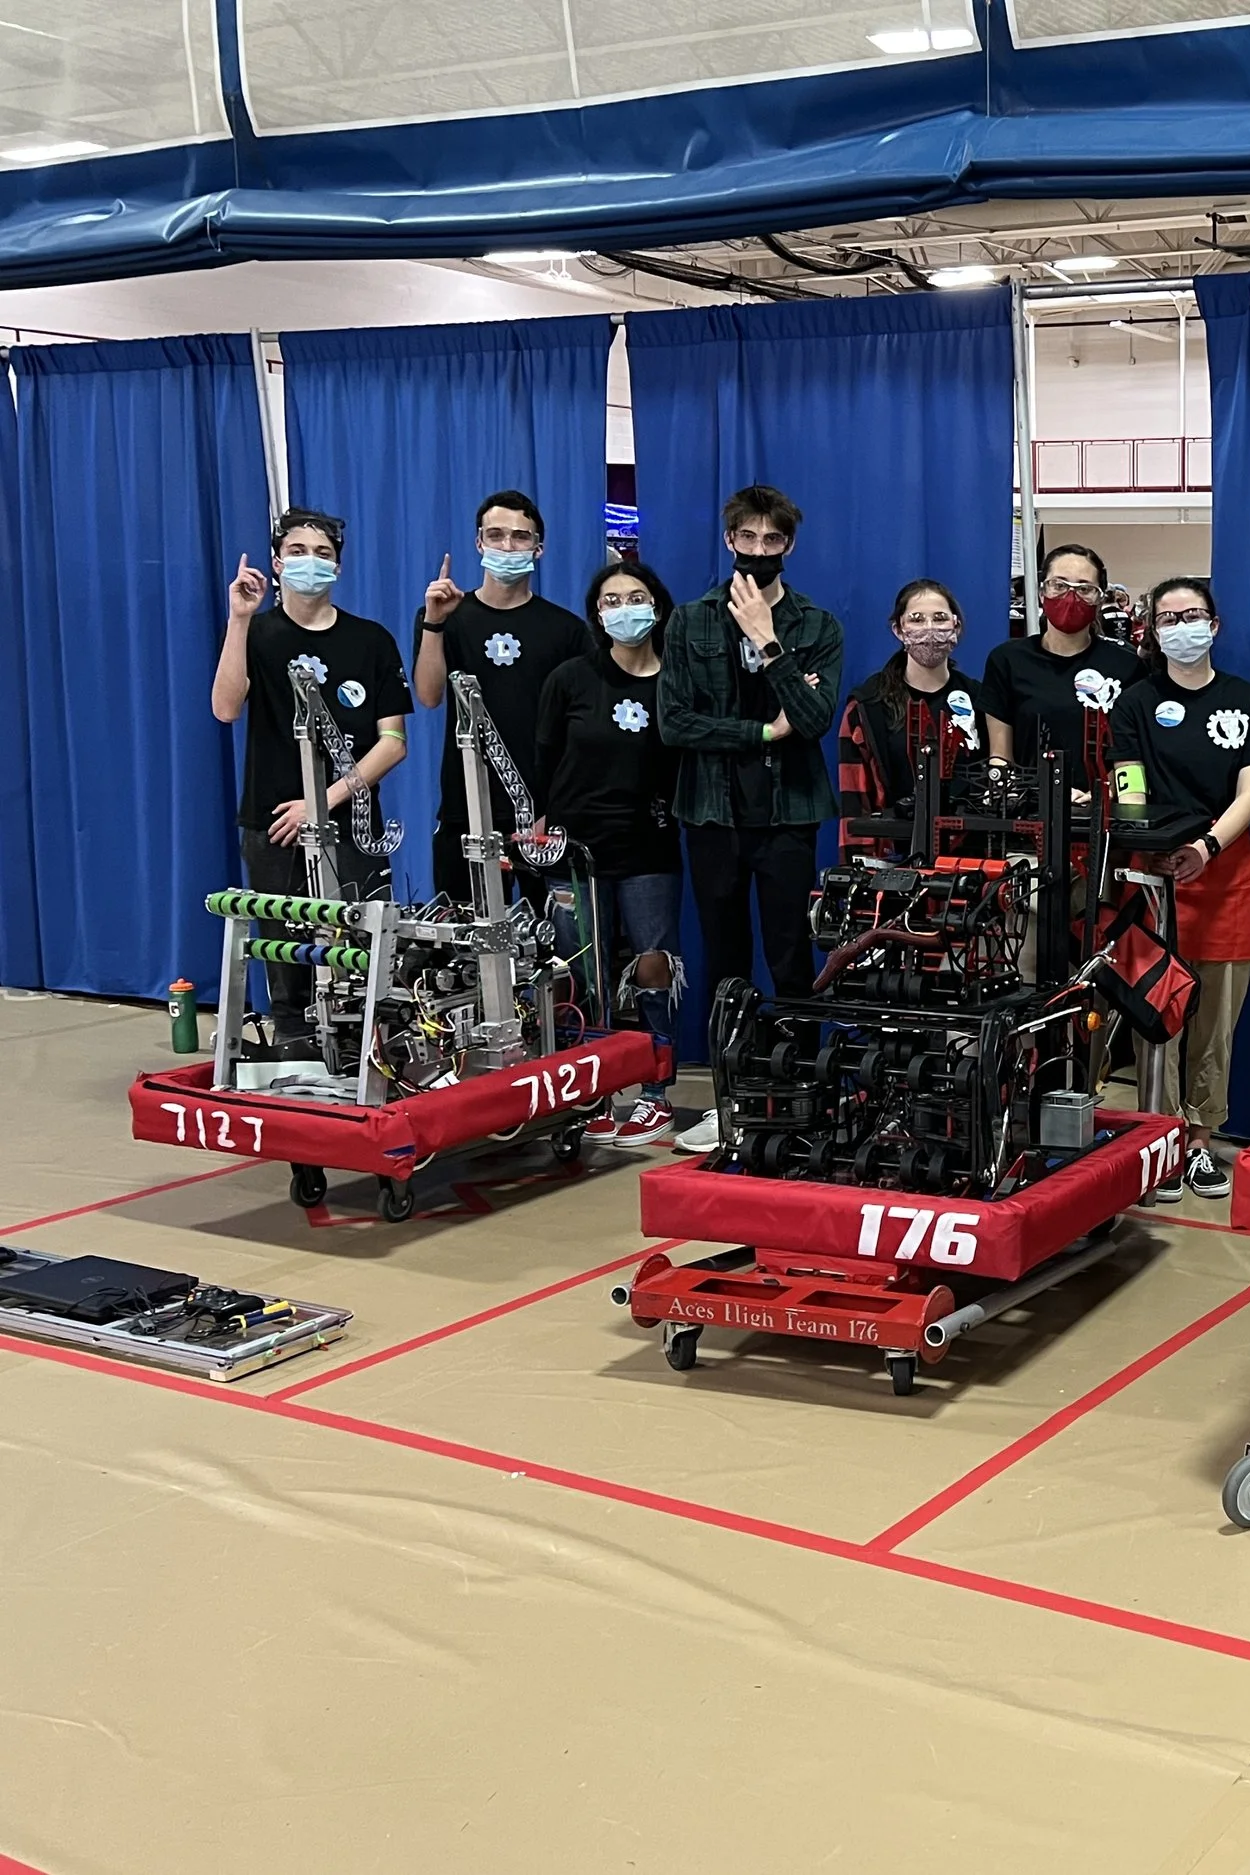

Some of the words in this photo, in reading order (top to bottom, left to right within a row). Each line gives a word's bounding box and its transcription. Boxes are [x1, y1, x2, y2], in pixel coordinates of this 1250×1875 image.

[1117, 771, 1129, 792] C
[511, 1054, 600, 1120] 7127
[160, 1103, 263, 1152] 7127
[858, 1204, 980, 1266] 176
[668, 1297, 715, 1320] Aces
[785, 1309, 838, 1336] Team
[848, 1320, 879, 1342] 176
